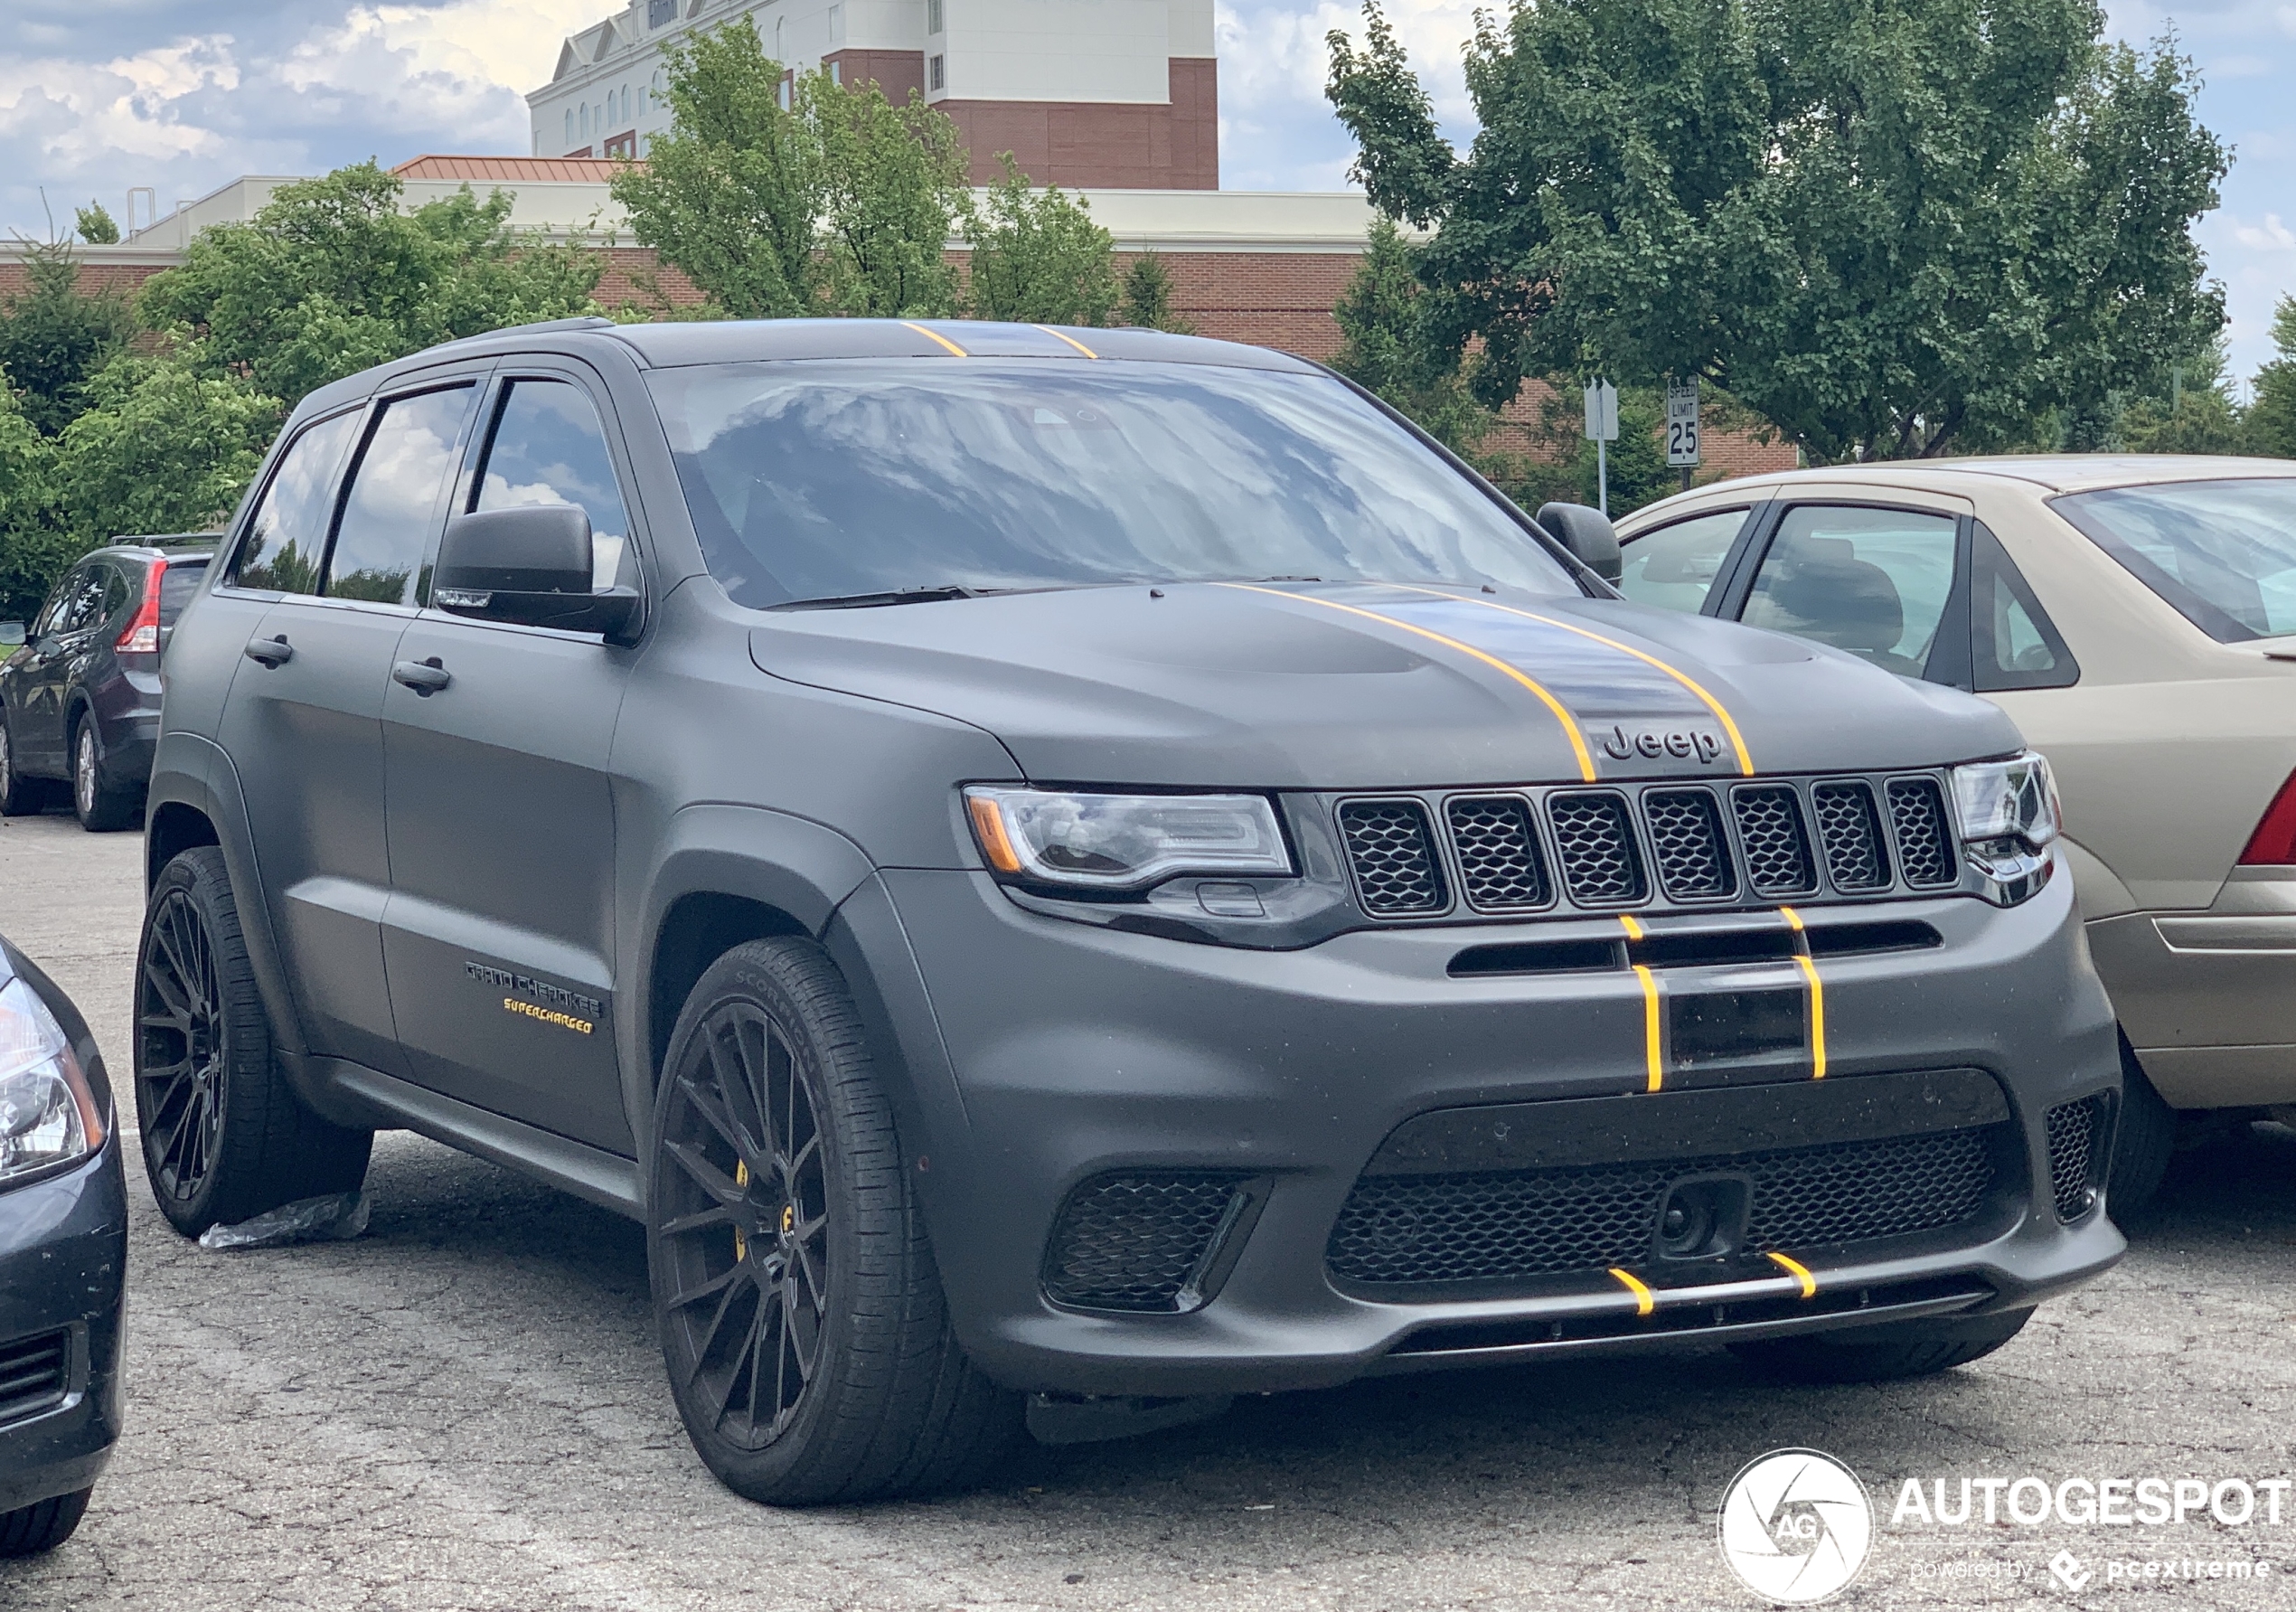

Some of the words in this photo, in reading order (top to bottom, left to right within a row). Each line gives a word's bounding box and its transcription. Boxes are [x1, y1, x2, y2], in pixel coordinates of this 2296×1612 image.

[1670, 383, 1696, 399] SPEED
[1672, 402, 1693, 418] LIMIT
[1670, 421, 1697, 455] 25
[1604, 725, 1722, 764] Jeep
[516, 975, 601, 1018] CHEROKEE
[503, 997, 593, 1034] SUPERCHARGED
